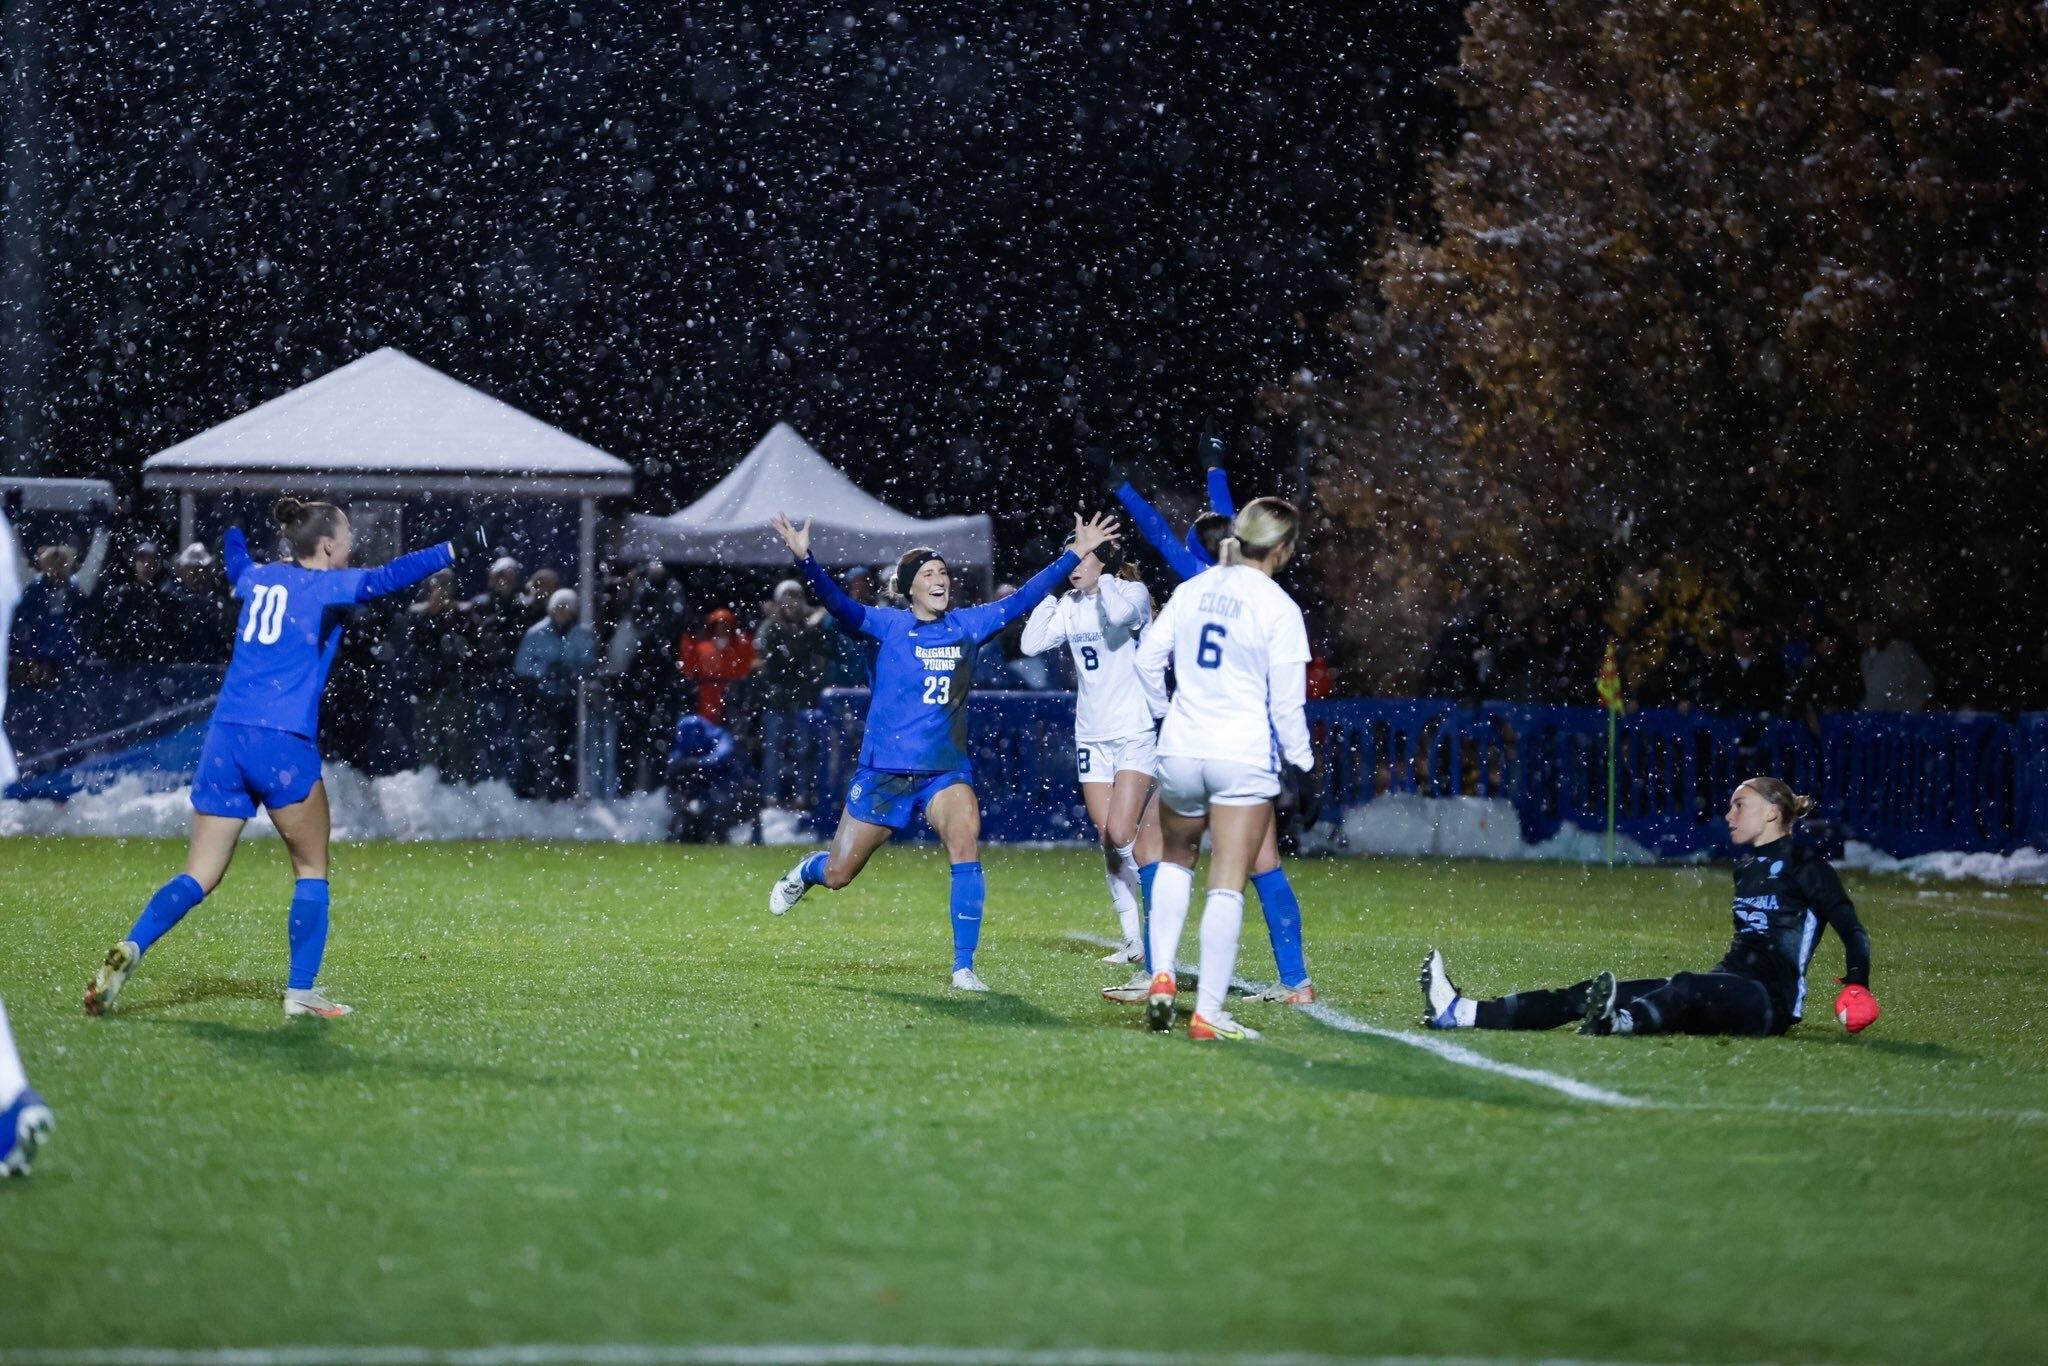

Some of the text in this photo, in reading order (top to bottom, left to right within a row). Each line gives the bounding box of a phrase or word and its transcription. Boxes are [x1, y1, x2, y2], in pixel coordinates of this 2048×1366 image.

[243, 584, 288, 645] 10
[1198, 592, 1244, 620] ELGIN
[915, 645, 962, 659] BRIGHAM
[1081, 646, 1099, 671] 8
[1197, 623, 1226, 669] 6
[923, 658, 956, 671] YOUNG
[923, 675, 951, 705] 23
